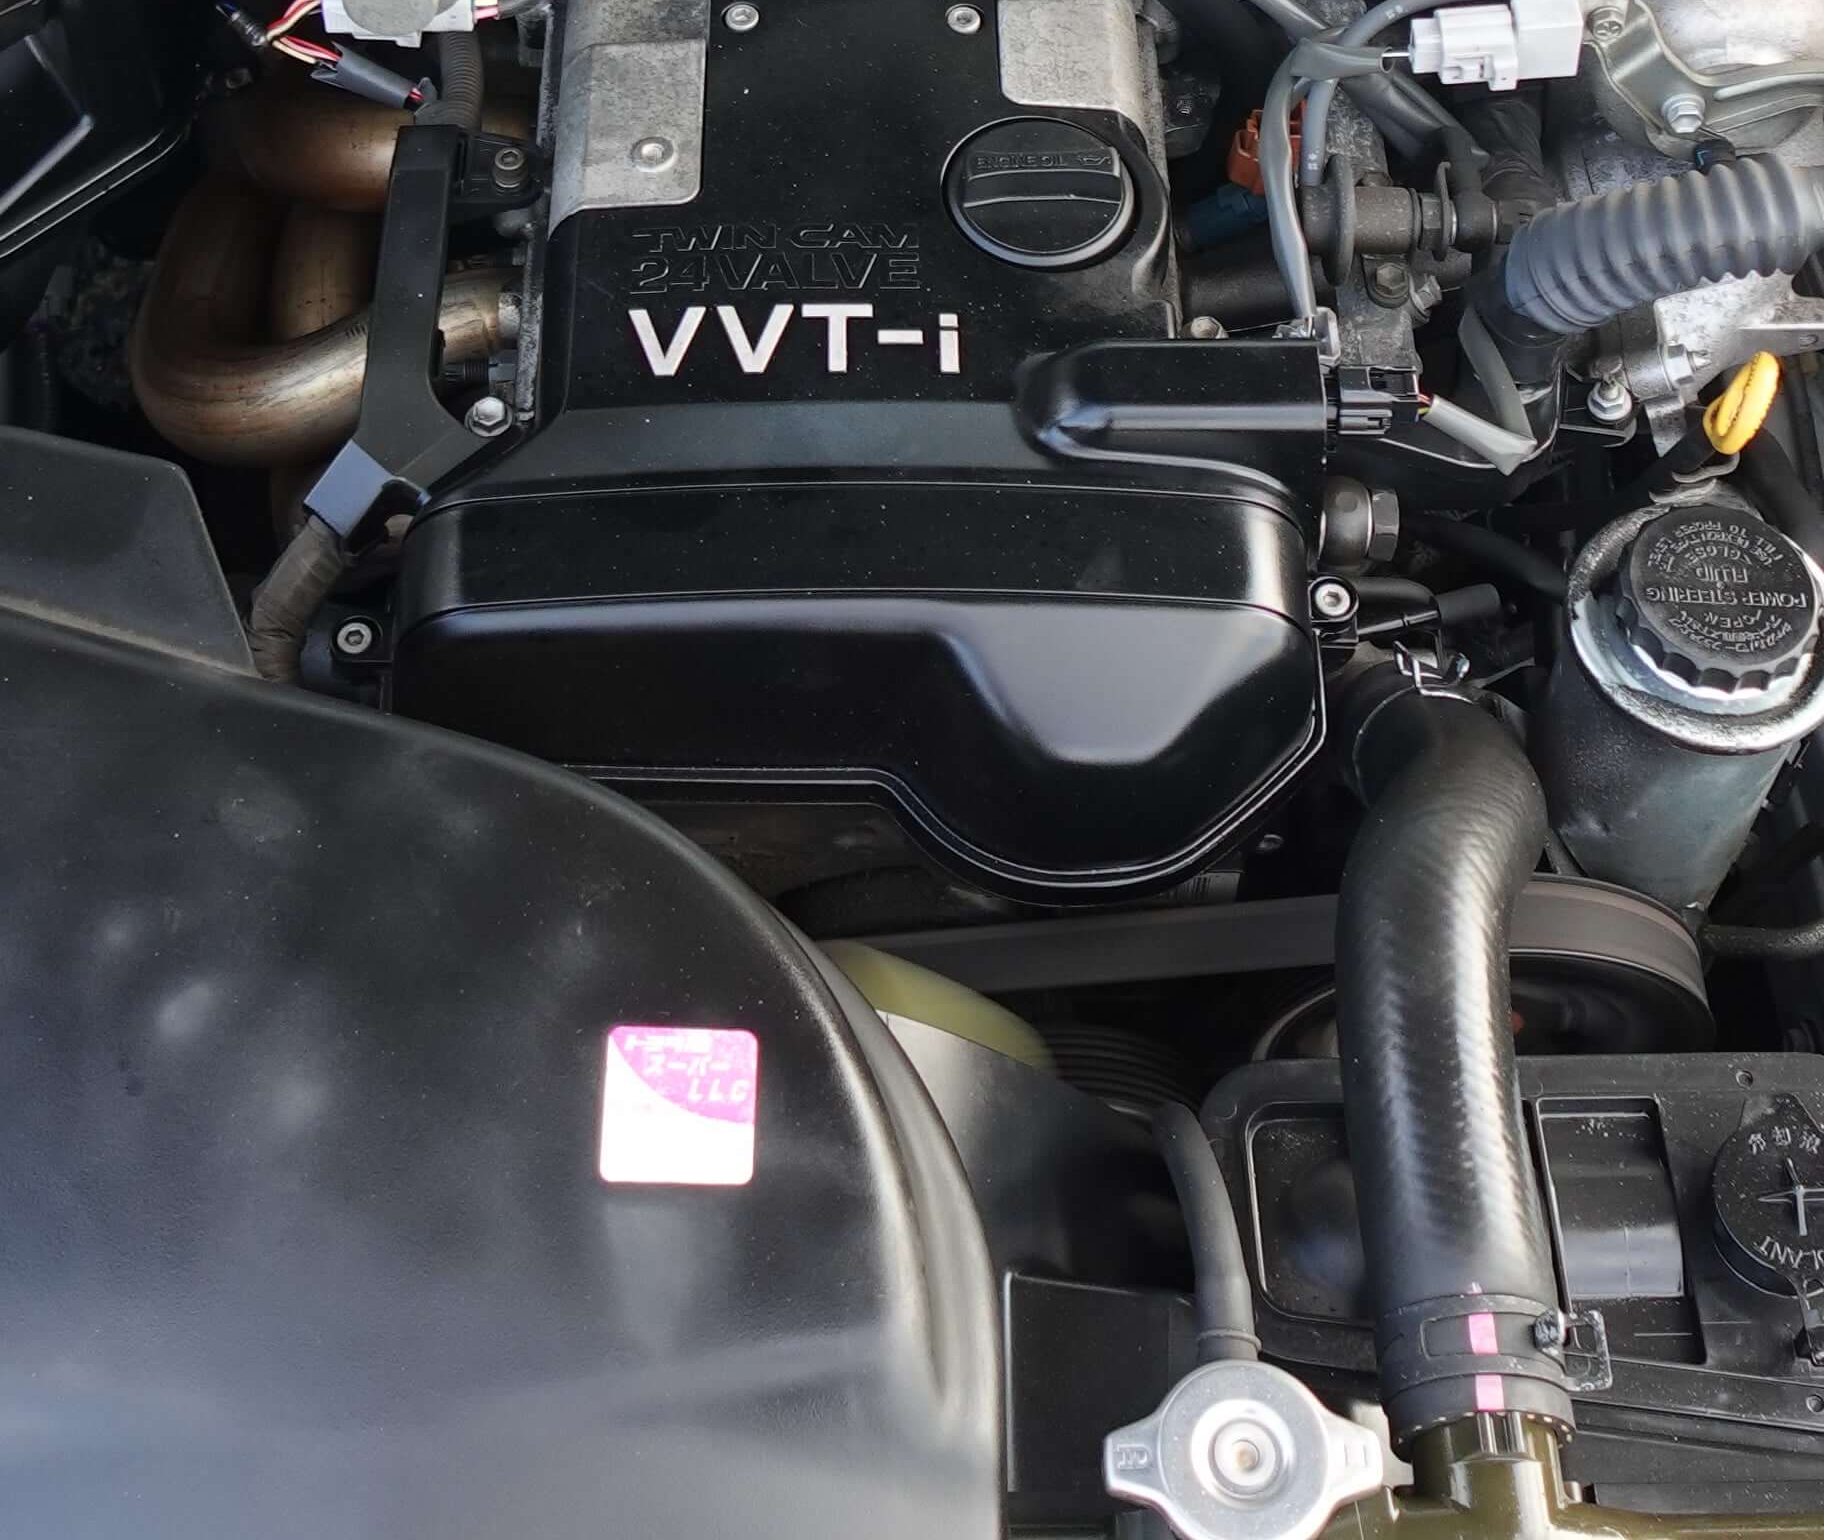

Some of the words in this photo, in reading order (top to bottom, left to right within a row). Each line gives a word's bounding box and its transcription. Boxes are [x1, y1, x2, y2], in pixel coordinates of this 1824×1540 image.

[976, 154, 1038, 170] ENGINE
[1041, 154, 1068, 168] OIL
[631, 223, 777, 253] TWIN
[789, 222, 920, 250] CAM
[627, 302, 961, 377] VVT-i
[1695, 564, 1749, 584] FLUID
[1645, 586, 1739, 606] STEERING
[1741, 591, 1809, 609] POWER
[686, 1078, 752, 1103] LLC
